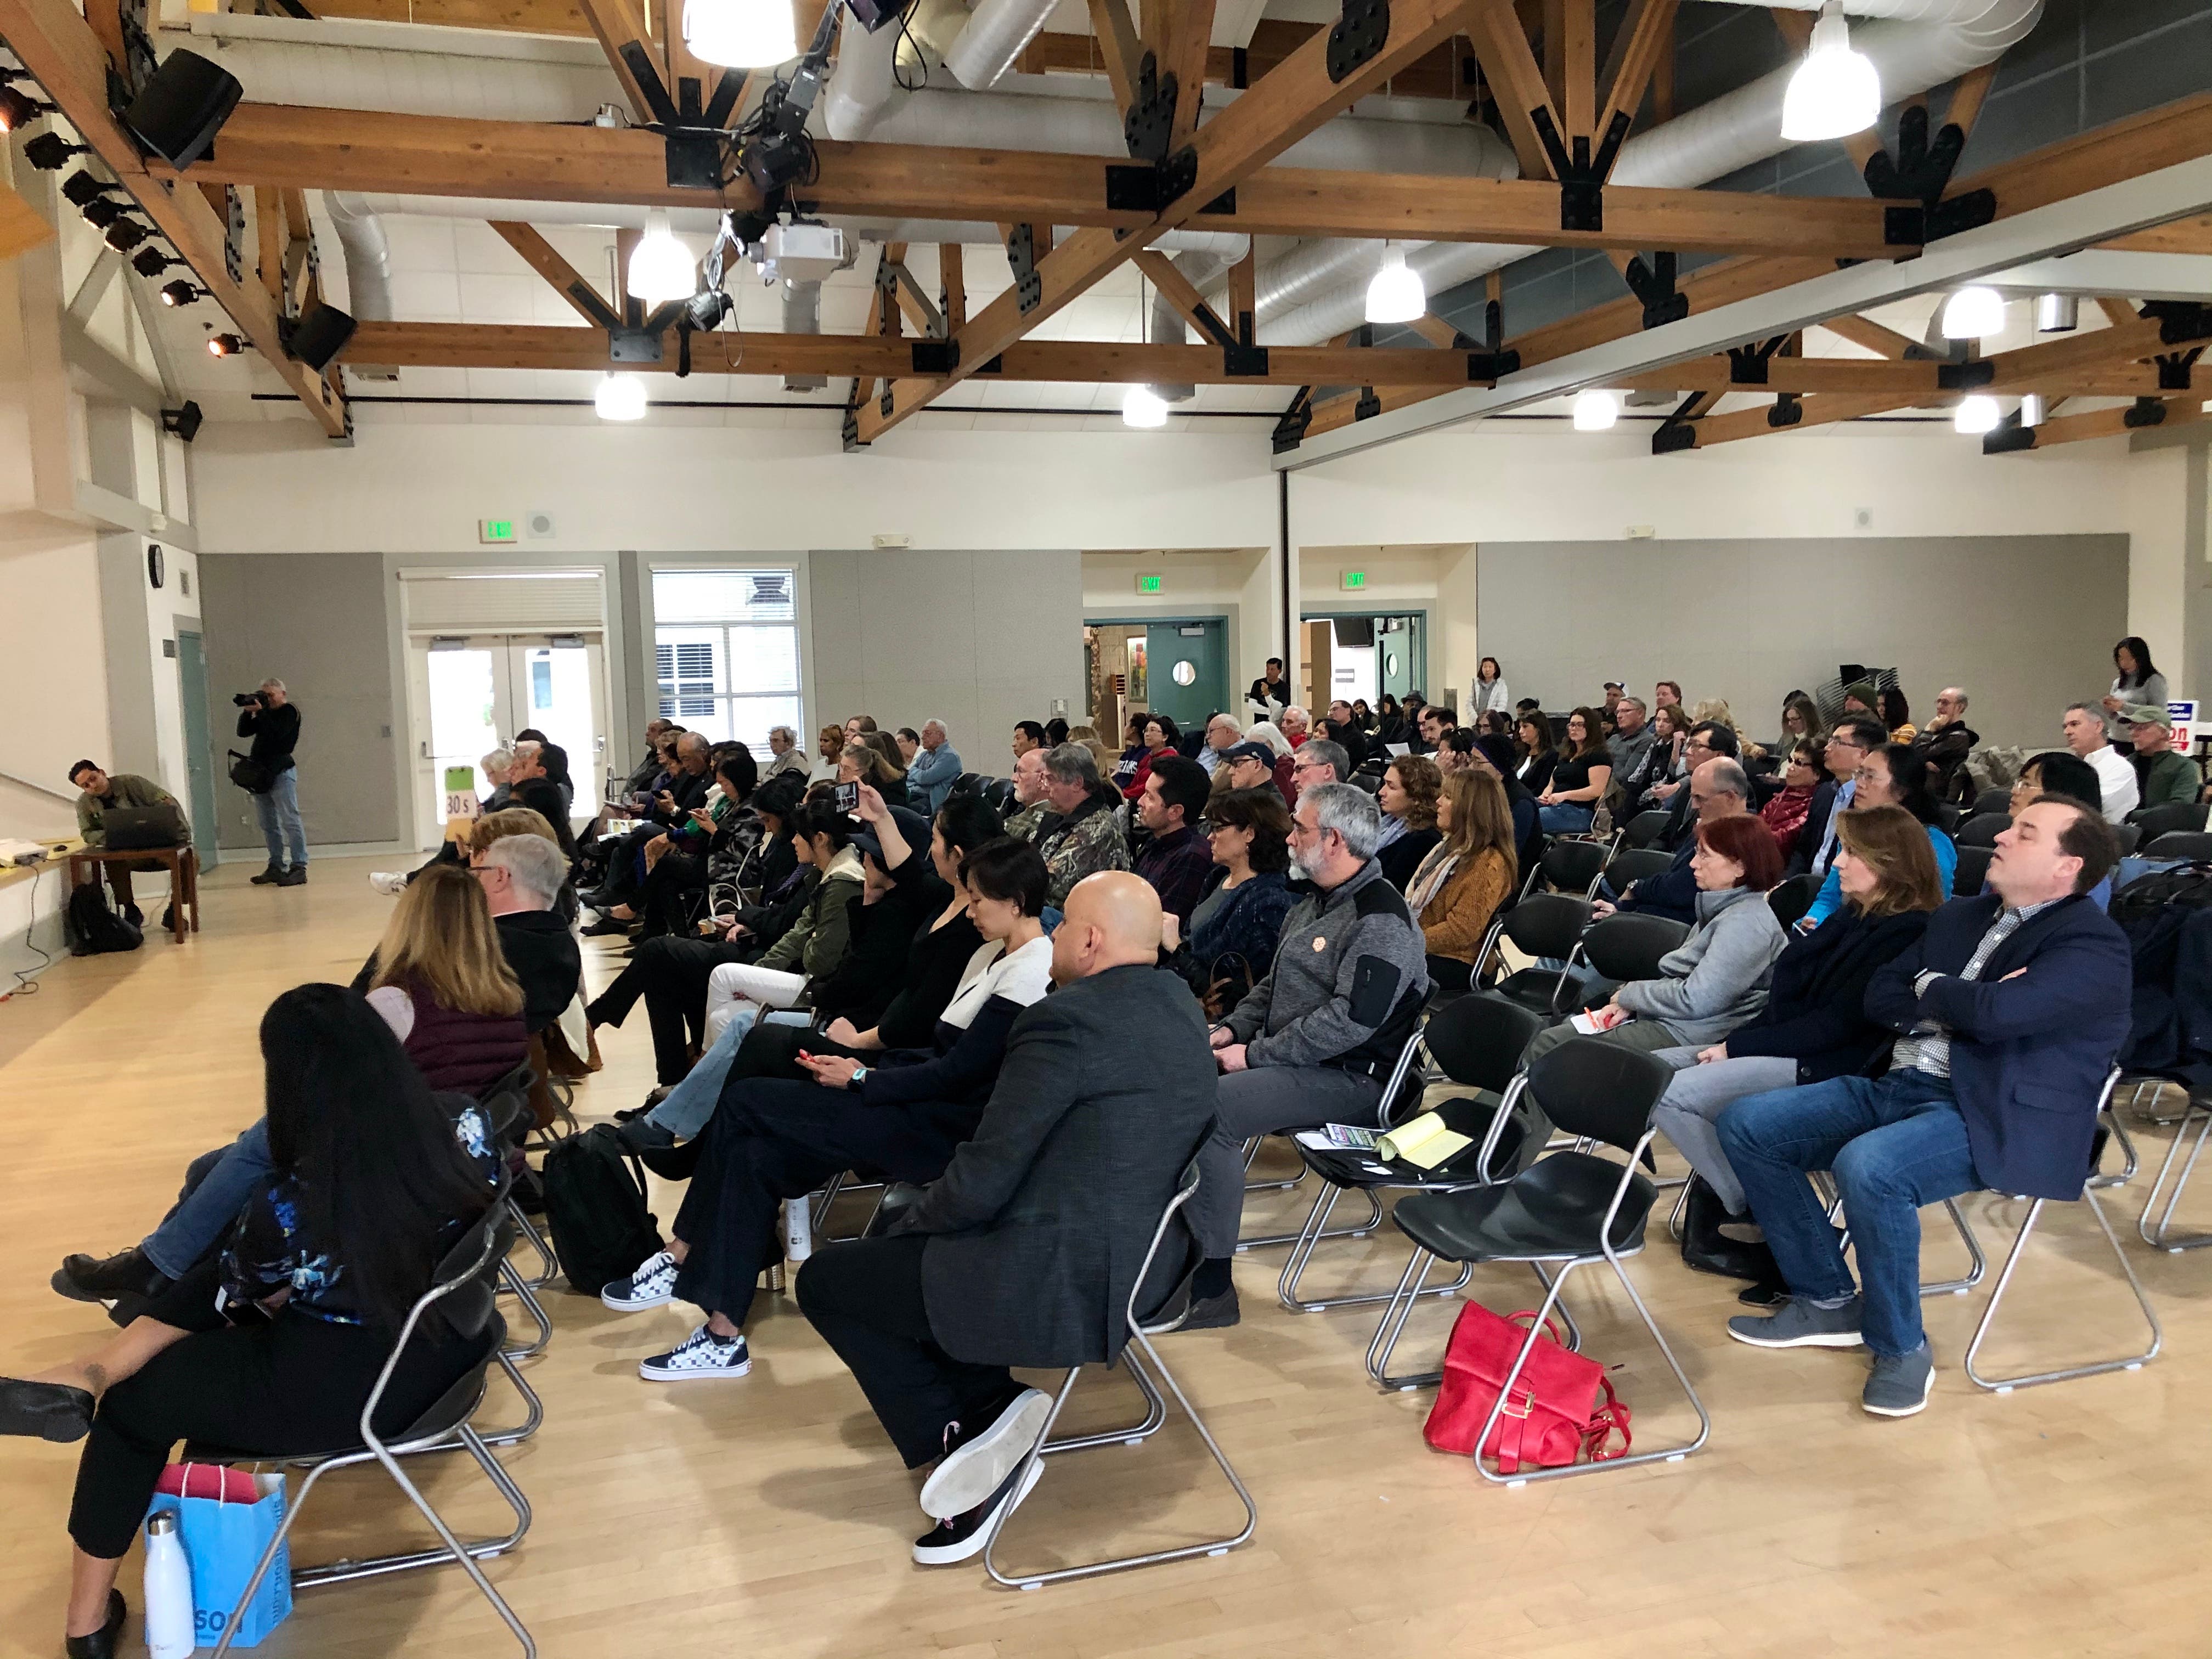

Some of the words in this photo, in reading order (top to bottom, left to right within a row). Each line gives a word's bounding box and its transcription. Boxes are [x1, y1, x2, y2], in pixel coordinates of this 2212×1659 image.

[487, 521, 511, 538] EXIT
[1142, 577, 1161, 592] EXIT
[1346, 572, 1364, 587] EXIT
[447, 795, 460, 814] 30
